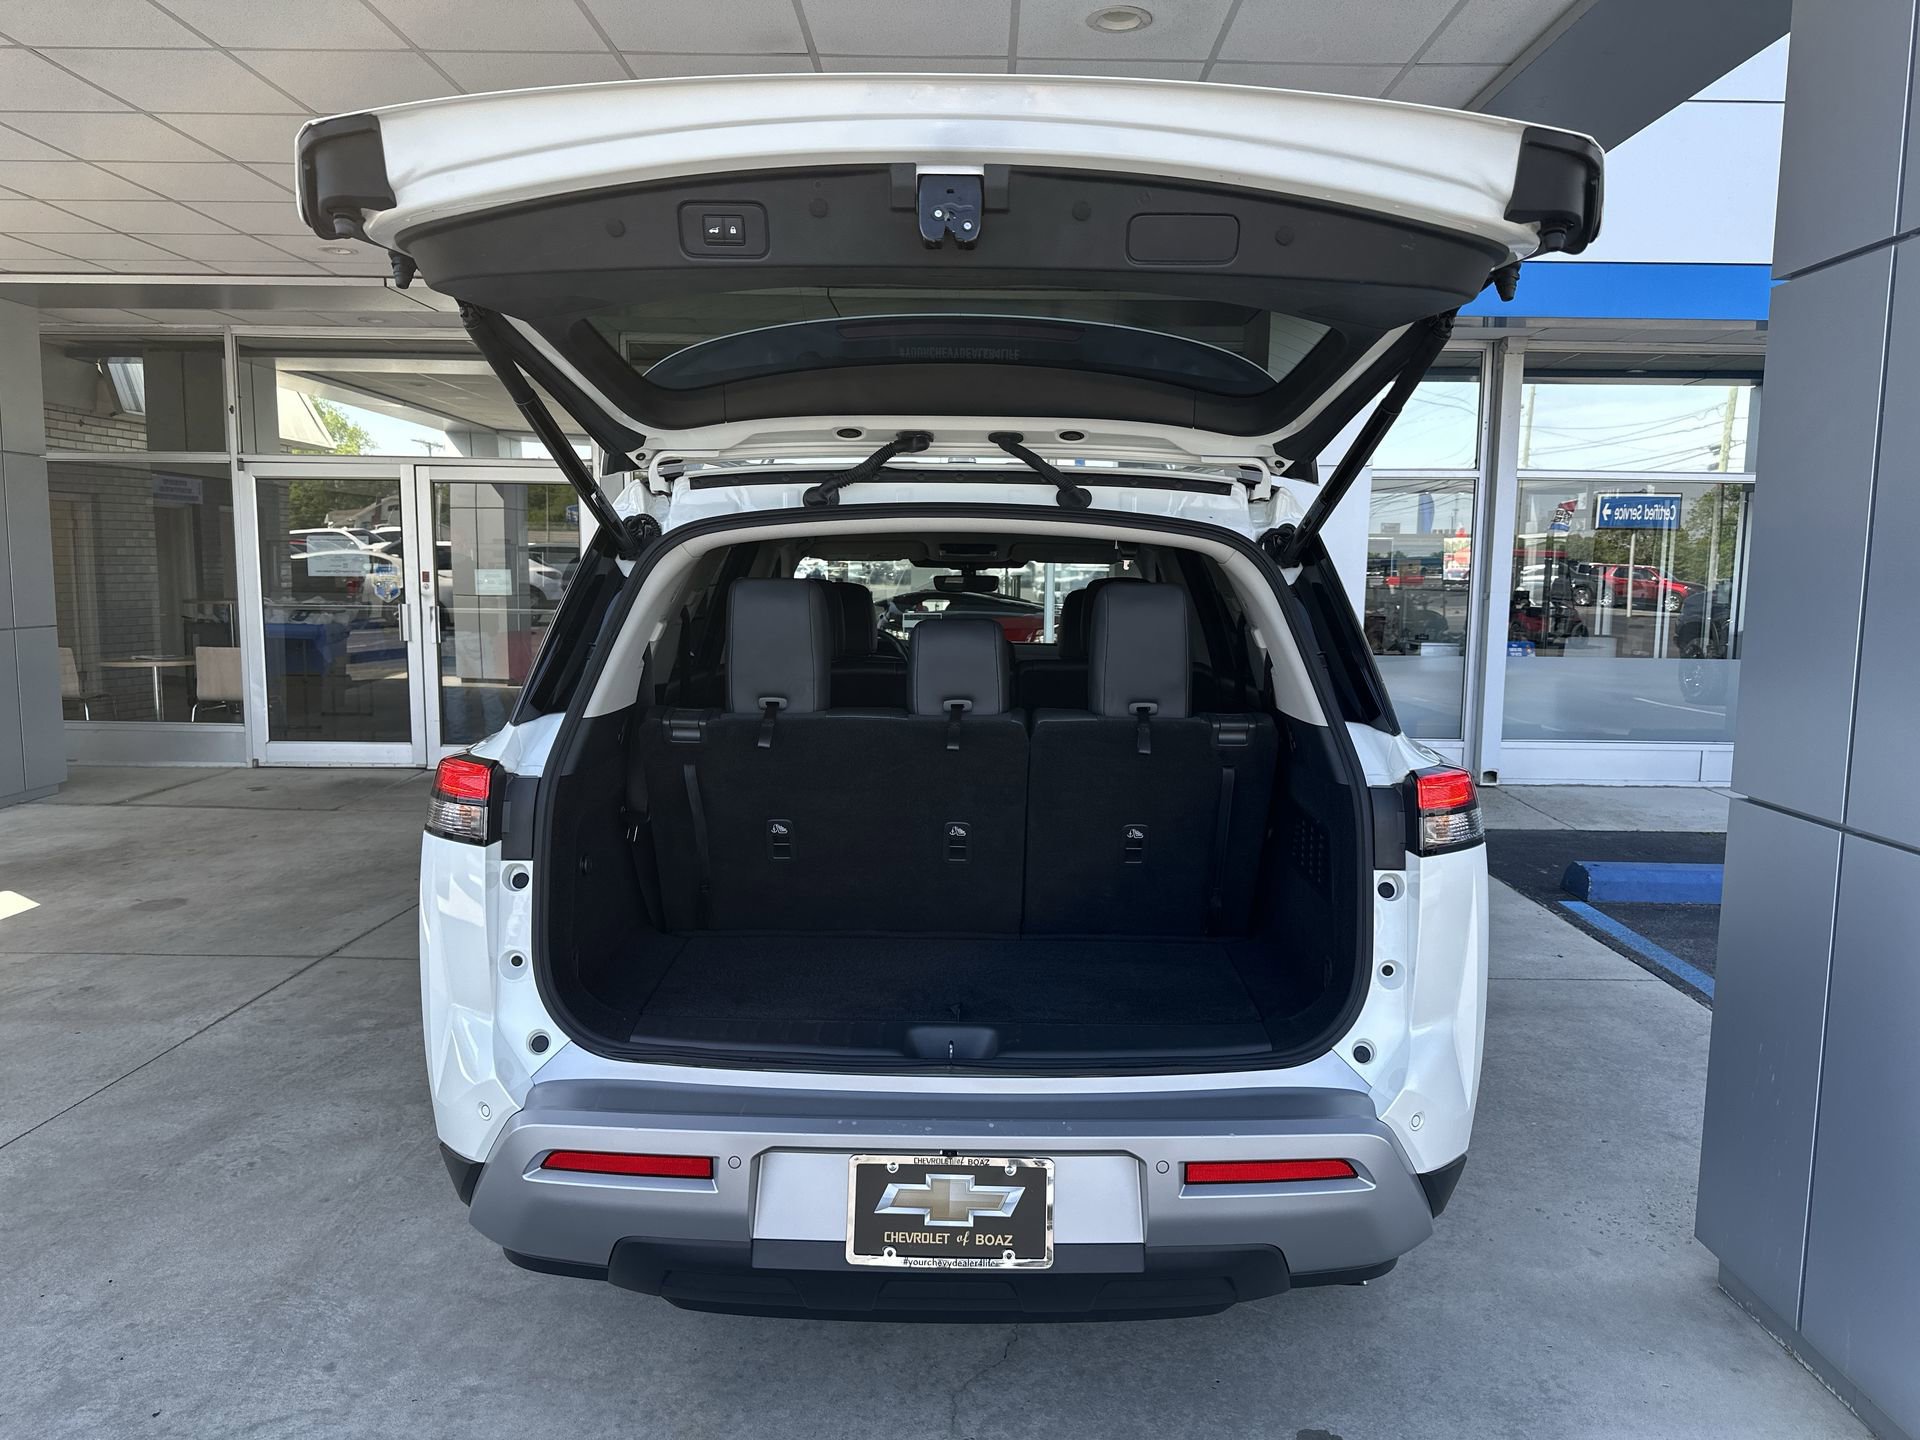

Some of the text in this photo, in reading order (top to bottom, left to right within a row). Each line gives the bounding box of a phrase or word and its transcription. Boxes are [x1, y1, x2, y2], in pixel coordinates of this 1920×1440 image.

[913, 1157, 990, 1166] CHEVROLET of BOAZ
[884, 1231, 1013, 1246] CHEVROLET of BOAZ
[903, 1258, 996, 1268] #yourchevydealer4life
